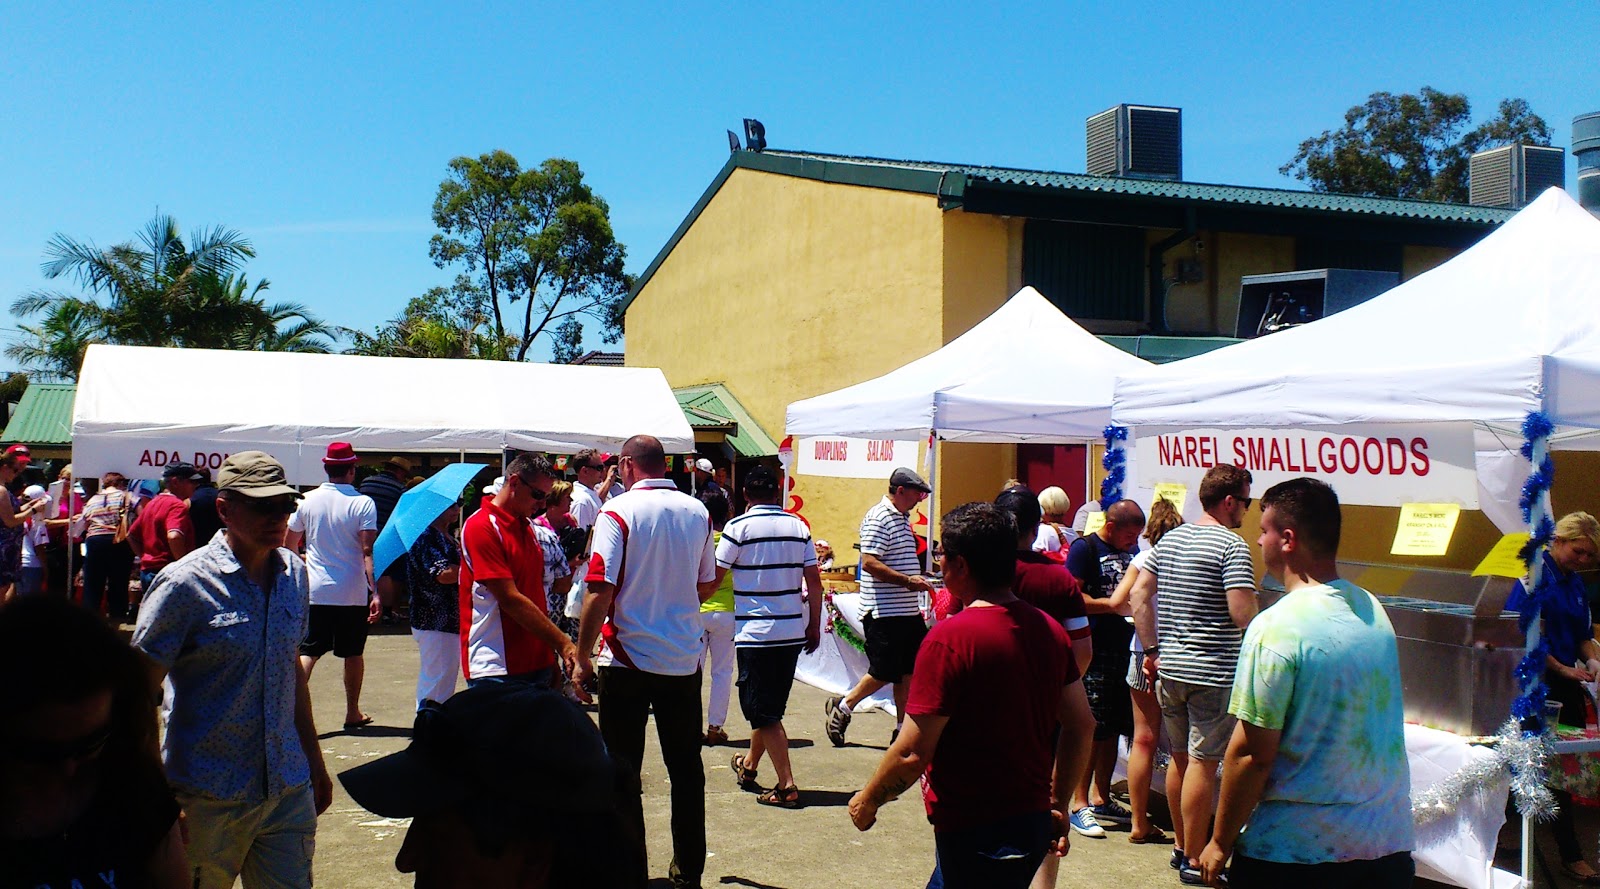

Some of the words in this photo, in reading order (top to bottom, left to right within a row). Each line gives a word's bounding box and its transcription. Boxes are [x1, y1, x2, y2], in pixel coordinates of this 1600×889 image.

[138, 449, 181, 467] ADA
[814, 440, 848, 461] DUMPLINGS
[866, 439, 894, 461] SALADS
[1158, 435, 1220, 468] NAREL
[1232, 436, 1430, 477] SMALLGOODS
